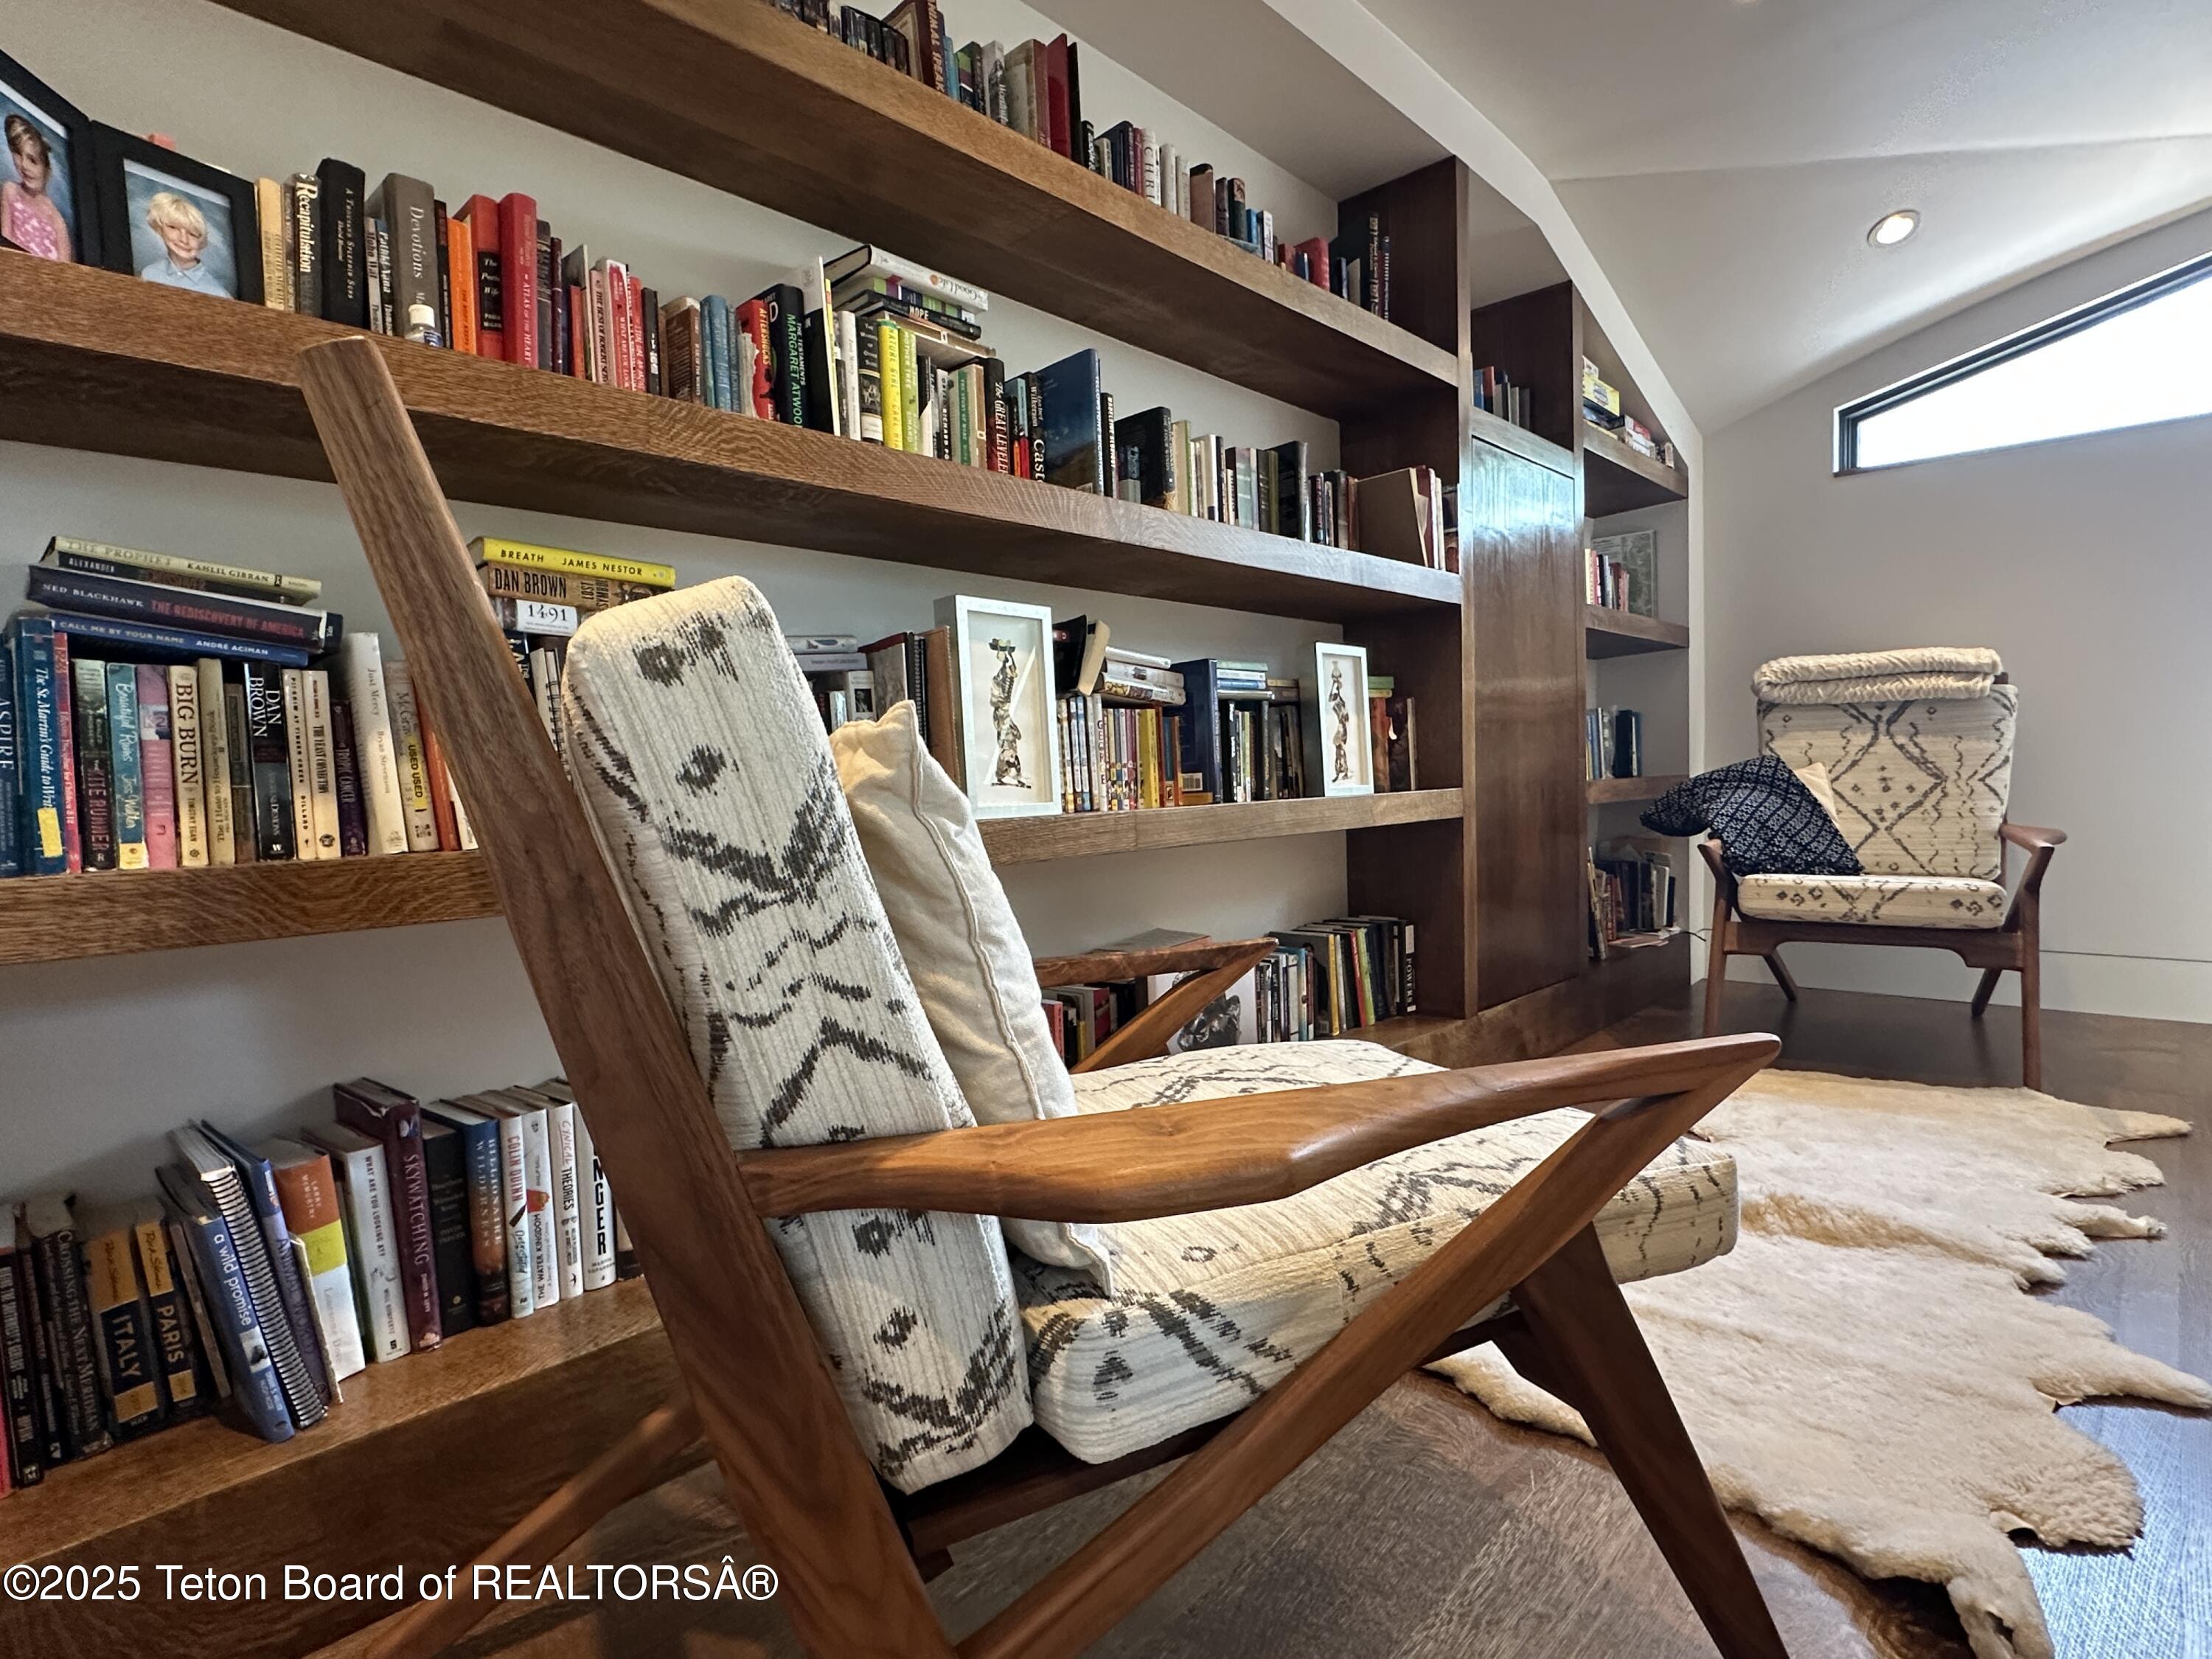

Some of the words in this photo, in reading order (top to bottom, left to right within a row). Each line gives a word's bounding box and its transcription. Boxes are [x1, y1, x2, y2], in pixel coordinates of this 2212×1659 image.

[928, 0, 939, 45] NIMAL
[296, 183, 318, 273] Recapitulation
[411, 206, 425, 279] Devotions
[909, 305, 929, 319] HOPE
[759, 307, 771, 366] AFTERSHOCKS
[787, 314, 799, 380] MARGARET
[888, 327, 897, 364] NATURE
[797, 338, 806, 386] TESTAMENTS
[792, 382, 803, 428] ATWOO
[995, 382, 1004, 399] The
[1030, 386, 1038, 427] Wilkerson
[995, 400, 1006, 433] GREAT
[69, 557, 114, 573] ALEXANDER
[105, 547, 170, 566] PROPHET
[187, 563, 226, 575] KAHLIL
[229, 570, 269, 582] GIBRAN
[501, 549, 544, 563] BREATH
[563, 557, 597, 570] JAMES
[602, 563, 643, 576] NESTOR
[495, 568, 519, 592] DAN
[524, 571, 567, 599] BROWN
[581, 581, 595, 600] LOST
[596, 578, 610, 608] SYMBOL
[42, 582, 68, 594] NED
[72, 589, 144, 608] BLACKHAWK
[151, 599, 170, 613] THE
[173, 602, 244, 625] REDISCOVERY
[260, 620, 305, 638] AMERICA
[528, 604, 568, 623] 1491
[60, 621, 88, 630] CALL
[125, 630, 153, 641] YOUR
[156, 635, 185, 644] NAME
[195, 640, 229, 650] ANDRÉ
[231, 644, 269, 655] ACIMAN
[35, 667, 49, 686] The
[36, 688, 49, 700] St.
[367, 669, 375, 687] Just
[115, 683, 133, 728] Beautiful
[175, 684, 195, 719] BIG
[249, 677, 268, 737] BROWN
[265, 689, 282, 725] DAN
[291, 677, 299, 712] PILGRIM
[370, 689, 380, 716] Mercy
[0, 700, 14, 771] ASPIRE
[37, 701, 52, 743] Martin's
[293, 714, 299, 724] AT
[39, 744, 54, 772] Guide
[119, 731, 136, 762] Ruins
[179, 727, 199, 785] BURN
[335, 747, 350, 776] TROPIC
[408, 744, 419, 770] USED
[122, 775, 137, 795] Jess
[340, 776, 355, 803] CANCER
[378, 756, 391, 793] Stevenson
[411, 771, 423, 798] USED
[90, 799, 110, 851] RUNNER
[124, 795, 140, 829] Walter
[187, 798, 195, 824] TIMOTHY
[300, 795, 309, 830] DILLARD
[189, 826, 197, 842] EGAN
[216, 825, 225, 842] The
[1405, 958, 1414, 1004] POWERS
[508, 1135, 521, 1168] COLIN
[561, 1120, 573, 1164] CYNICAL
[365, 1155, 375, 1177] WHAT
[302, 1173, 316, 1220] McMURTRY
[312, 1180, 321, 1208] LARRY
[370, 1194, 378, 1210] YOU
[475, 1139, 492, 1248] WILDERNESS
[487, 1138, 503, 1245] BILLIONAIRE
[509, 1170, 524, 1202] QUINN
[561, 1166, 574, 1211] THEORIES
[372, 1210, 383, 1243] LOOKING
[403, 1154, 430, 1267] SKYWATCHING
[214, 1234, 225, 1244] a
[377, 1244, 385, 1257] AT?
[533, 1214, 543, 1252] KINGDOM
[58, 1231, 78, 1299] CROSSING
[219, 1245, 240, 1273] wild
[276, 1237, 296, 1295] ANIMAL
[535, 1254, 544, 1283] WATER
[69, 1299, 82, 1325] THE
[223, 1276, 254, 1326] promise
[324, 1287, 341, 1336] Lonesome
[73, 1324, 89, 1363] NEXT
[111, 1315, 142, 1379] ITALY
[158, 1304, 184, 1365] PARIS
[79, 1362, 100, 1433] MERIDIAN
